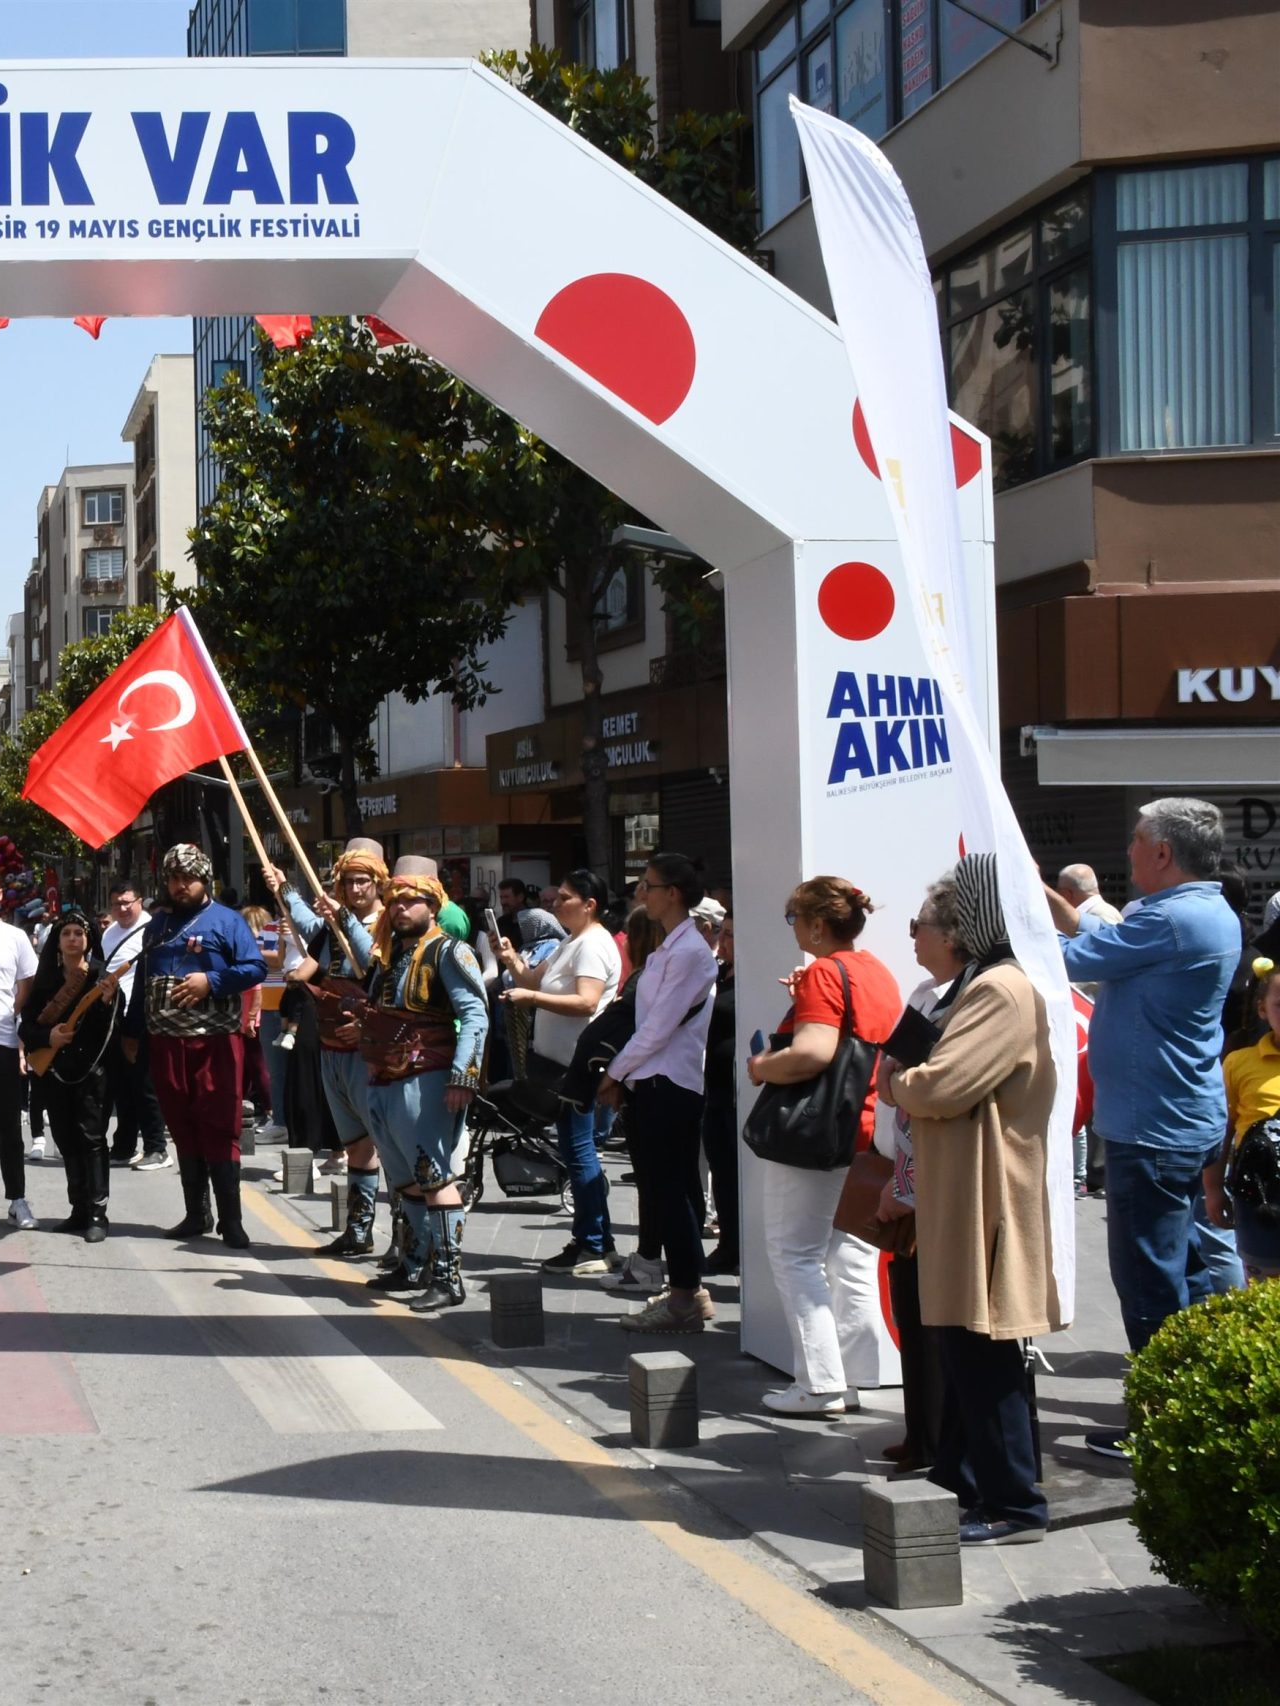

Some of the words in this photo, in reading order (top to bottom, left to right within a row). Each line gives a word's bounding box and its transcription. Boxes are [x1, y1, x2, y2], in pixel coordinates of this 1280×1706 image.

[130, 111, 359, 205] VAR
[35, 219, 60, 239] 19
[69, 219, 140, 238] MAYIS
[148, 212, 242, 243] GENÇLİK
[250, 212, 361, 238] FESTİVALİ
[827, 718, 951, 785] AKIN
